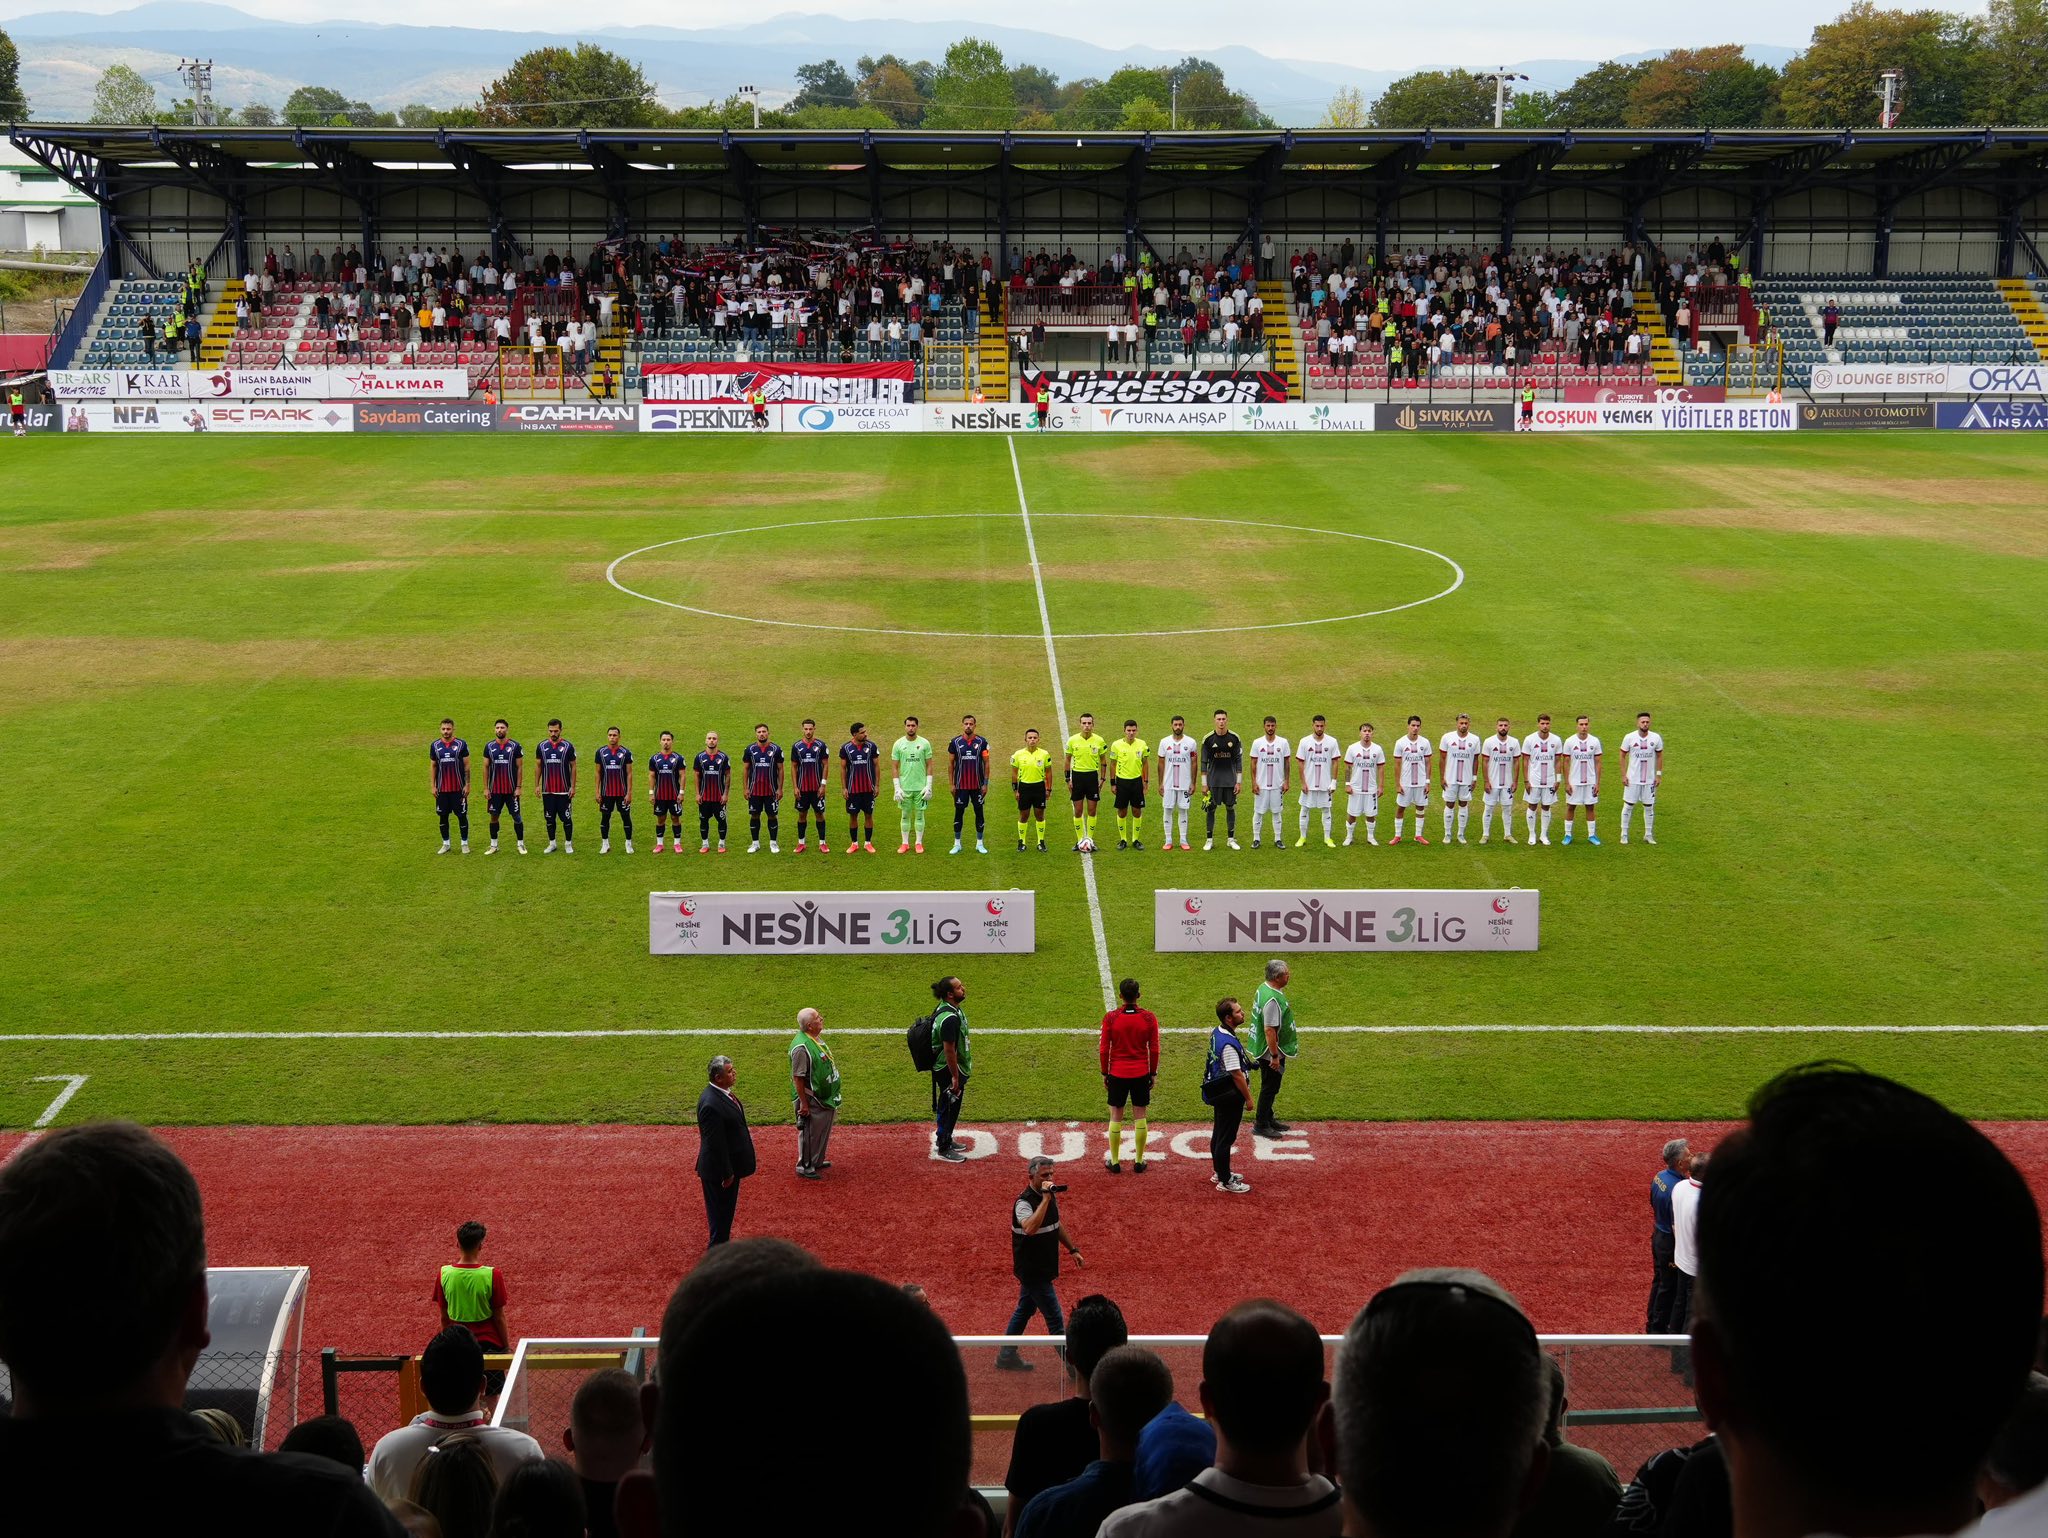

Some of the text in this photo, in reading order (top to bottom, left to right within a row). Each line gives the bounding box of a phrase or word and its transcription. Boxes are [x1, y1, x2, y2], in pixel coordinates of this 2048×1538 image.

[56, 373, 111, 385] ER-ARS
[144, 374, 182, 387] KAR
[239, 374, 311, 384] İHSAN BABANIN
[362, 380, 444, 389] HALKMAR
[1836, 373, 1892, 385] LOUNGE
[1897, 372, 1945, 385] BISTRO
[1046, 376, 1260, 403] DÜZCESPOR
[113, 406, 159, 423] NFA
[250, 409, 314, 421] PARK
[359, 408, 491, 426] Saydam Catering
[838, 407, 910, 417] DÜZCE FLOAT
[1662, 405, 1791, 428] YİĞİTLER BETON
[1820, 405, 1928, 418] ARKUN OTOMOTİV
[858, 421, 890, 430] GLASS
[1125, 412, 1227, 426] TURNA AHŞAP
[1254, 418, 1299, 430] DMALL
[1321, 418, 1366, 430] DMALL
[1536, 410, 1653, 428] COŞKUN YEMEK
[929, 1119, 1316, 1162] DÜZCE
